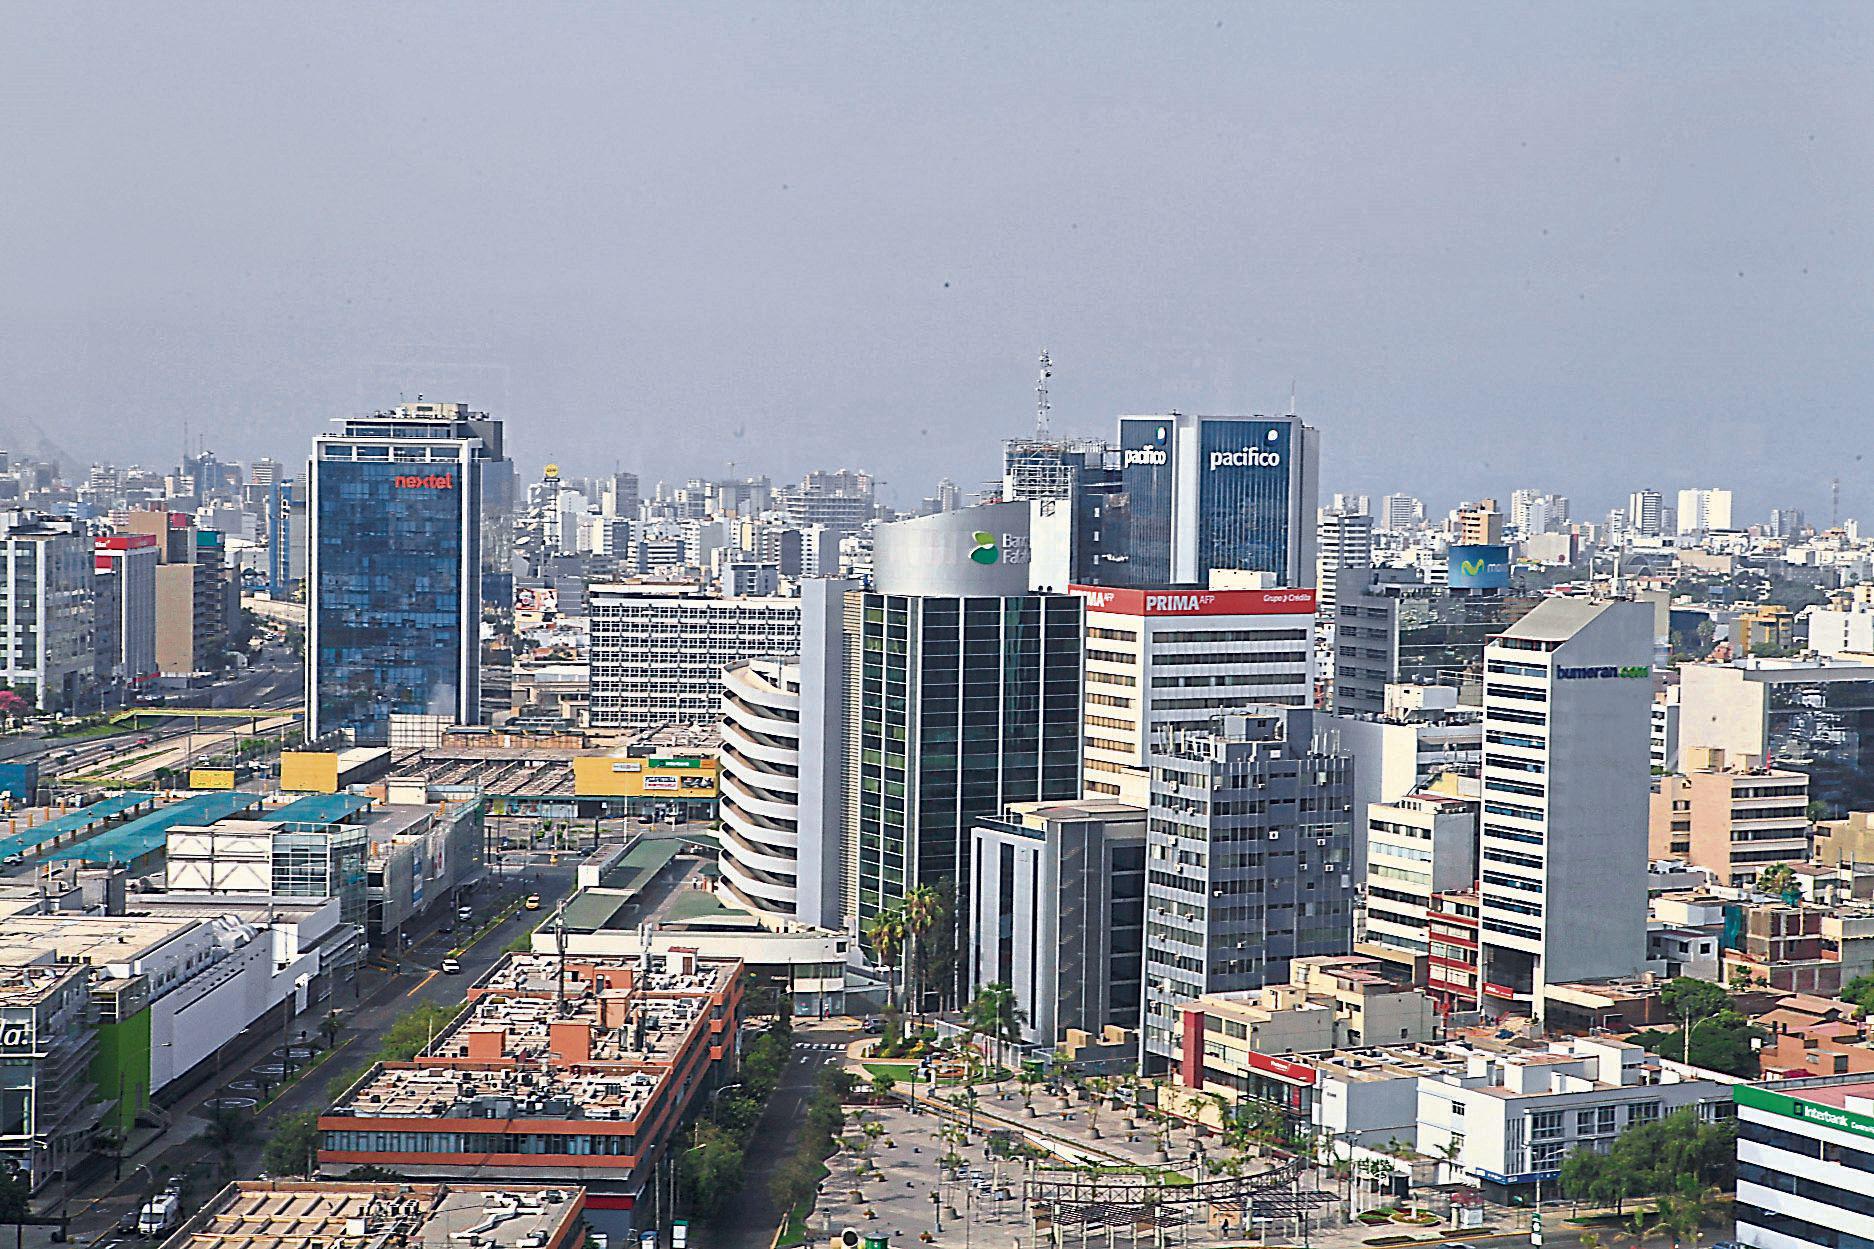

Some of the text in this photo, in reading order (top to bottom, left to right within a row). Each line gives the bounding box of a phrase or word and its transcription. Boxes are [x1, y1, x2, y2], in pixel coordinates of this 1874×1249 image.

[1124, 445, 1167, 468] pacifico
[1210, 446, 1280, 470] pacifico
[394, 472, 453, 489] nextel
[1146, 595, 1216, 611] PRIMA AFP
[1804, 1106, 1848, 1127] Interbank
